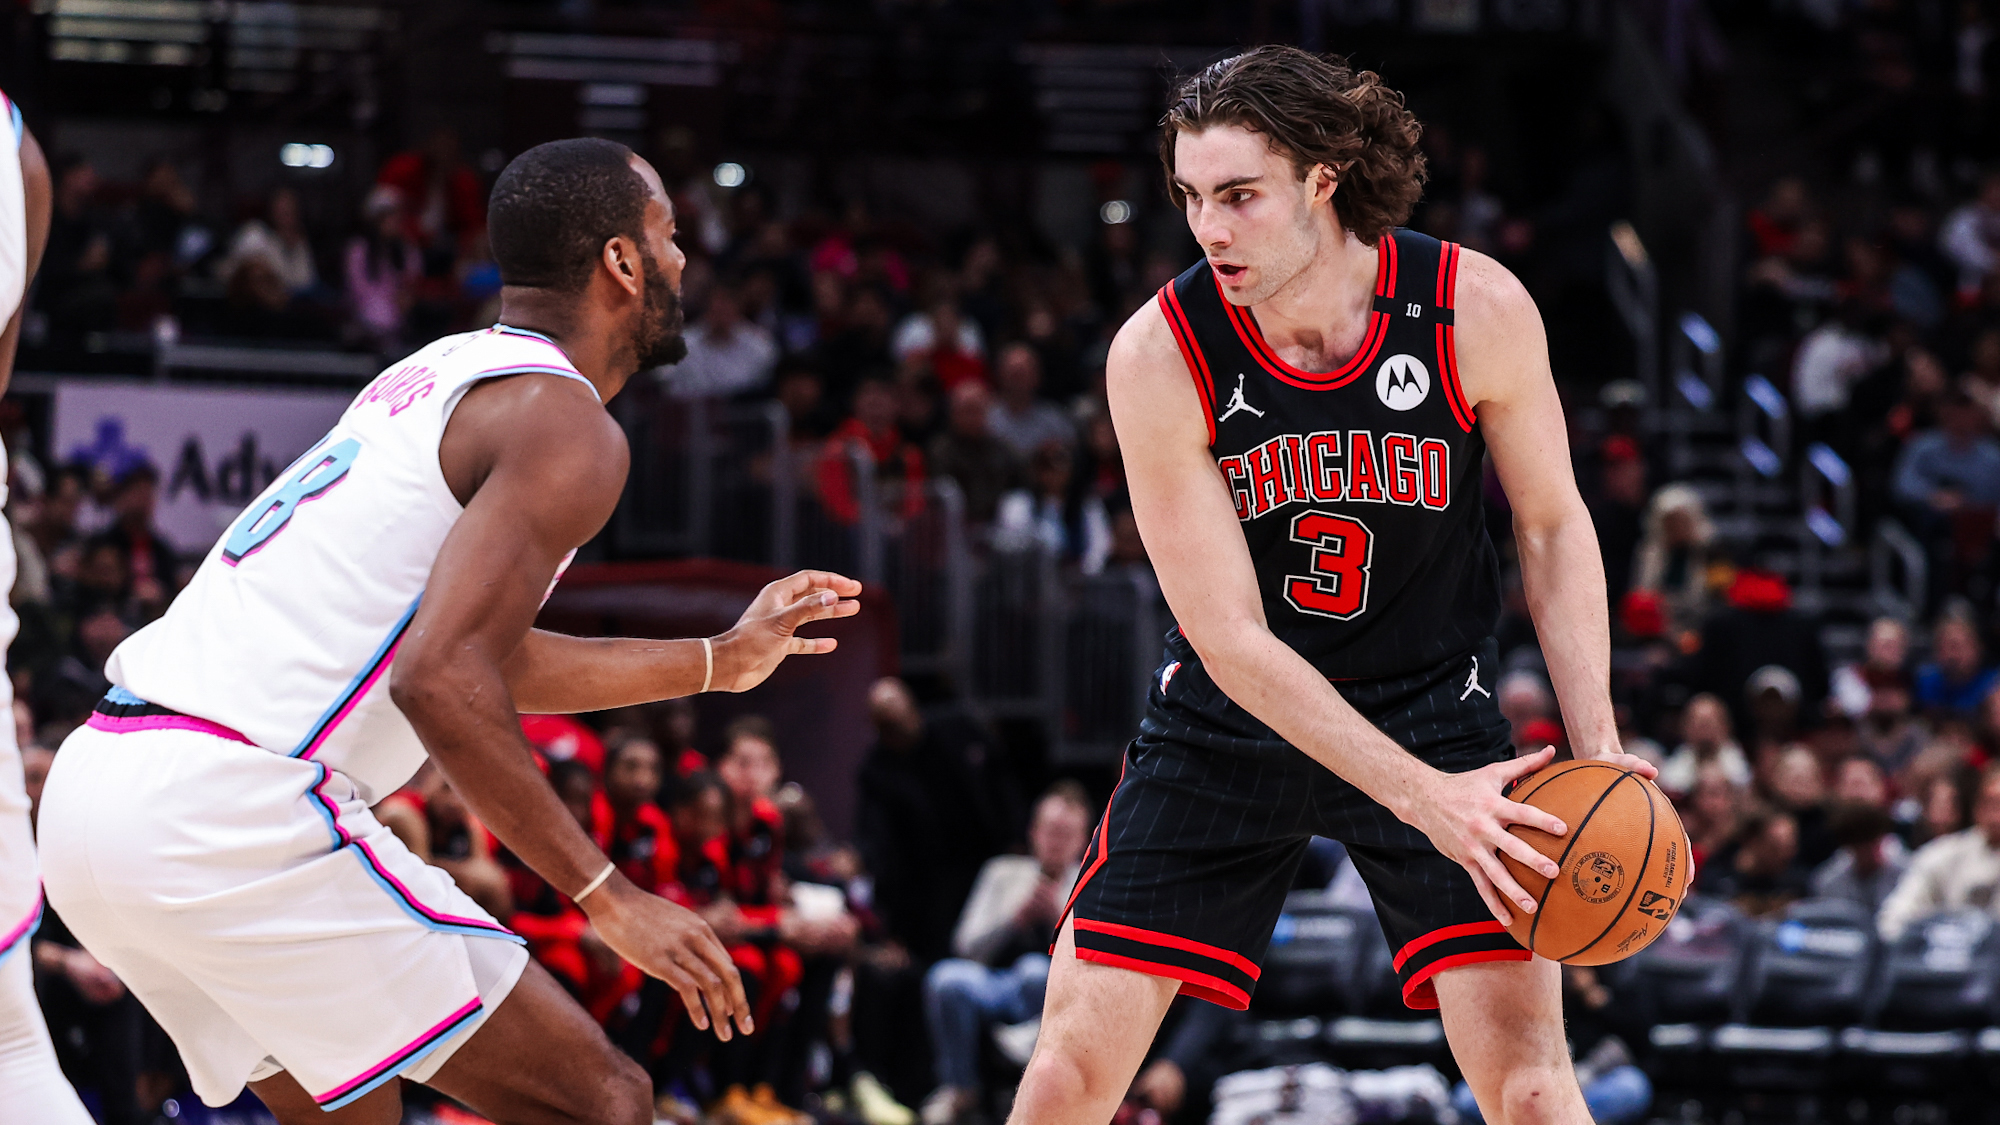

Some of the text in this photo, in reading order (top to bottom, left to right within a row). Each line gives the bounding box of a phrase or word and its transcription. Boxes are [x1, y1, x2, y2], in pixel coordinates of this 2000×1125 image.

[1405, 302, 1422, 319] 10
[354, 365, 438, 417] BURKS
[221, 436, 362, 568] 8
[1218, 430, 1450, 522] CHICAGO
[1283, 508, 1374, 622] 3
